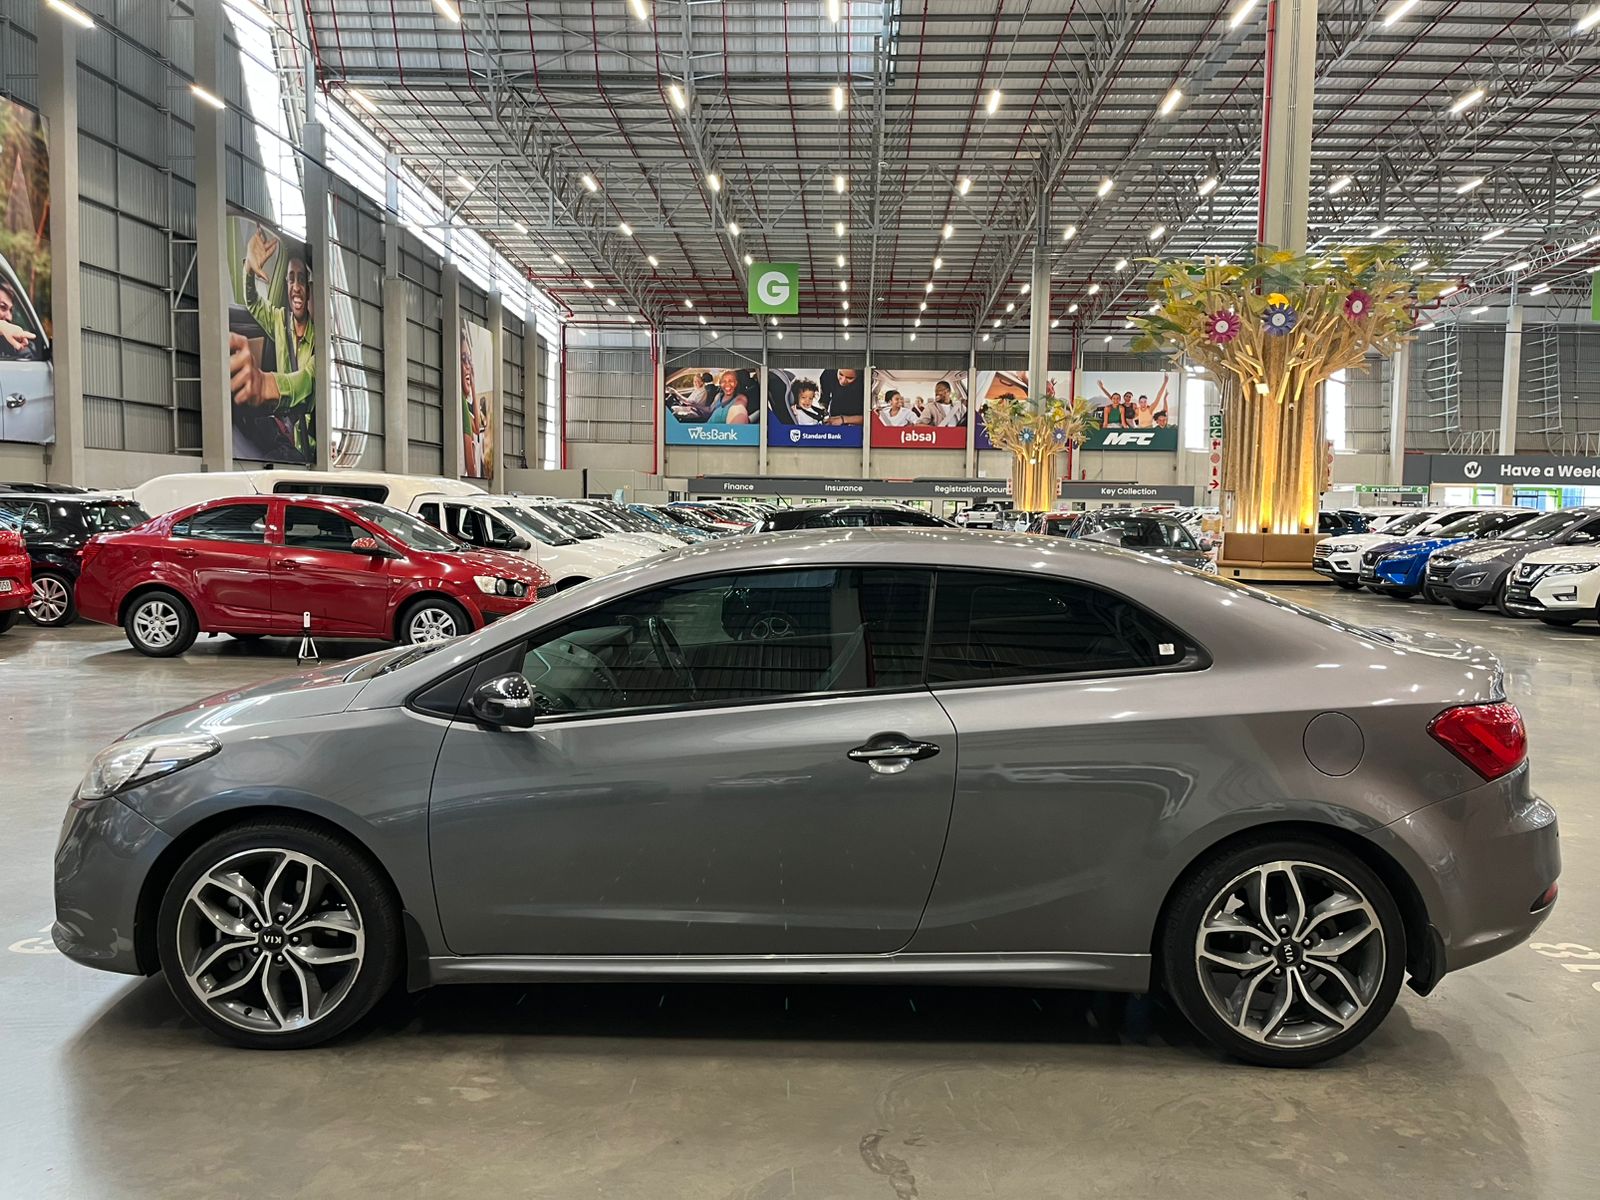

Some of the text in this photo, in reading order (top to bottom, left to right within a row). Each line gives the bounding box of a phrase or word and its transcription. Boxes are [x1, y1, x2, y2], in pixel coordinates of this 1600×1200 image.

[757, 271, 790, 306] G
[687, 426, 738, 441] WesBank
[802, 432, 826, 440] Standard
[900, 430, 936, 443] (absa)
[1103, 432, 1155, 446] MFC
[1500, 464, 1541, 476] Have
[1543, 467, 1554, 476] a
[723, 482, 754, 491] Finance
[824, 484, 863, 492] Insurance
[934, 485, 981, 494] Registration
[1101, 488, 1157, 497] Key Collection
[264, 935, 282, 943] KIA
[1283, 944, 1294, 963] KIA
